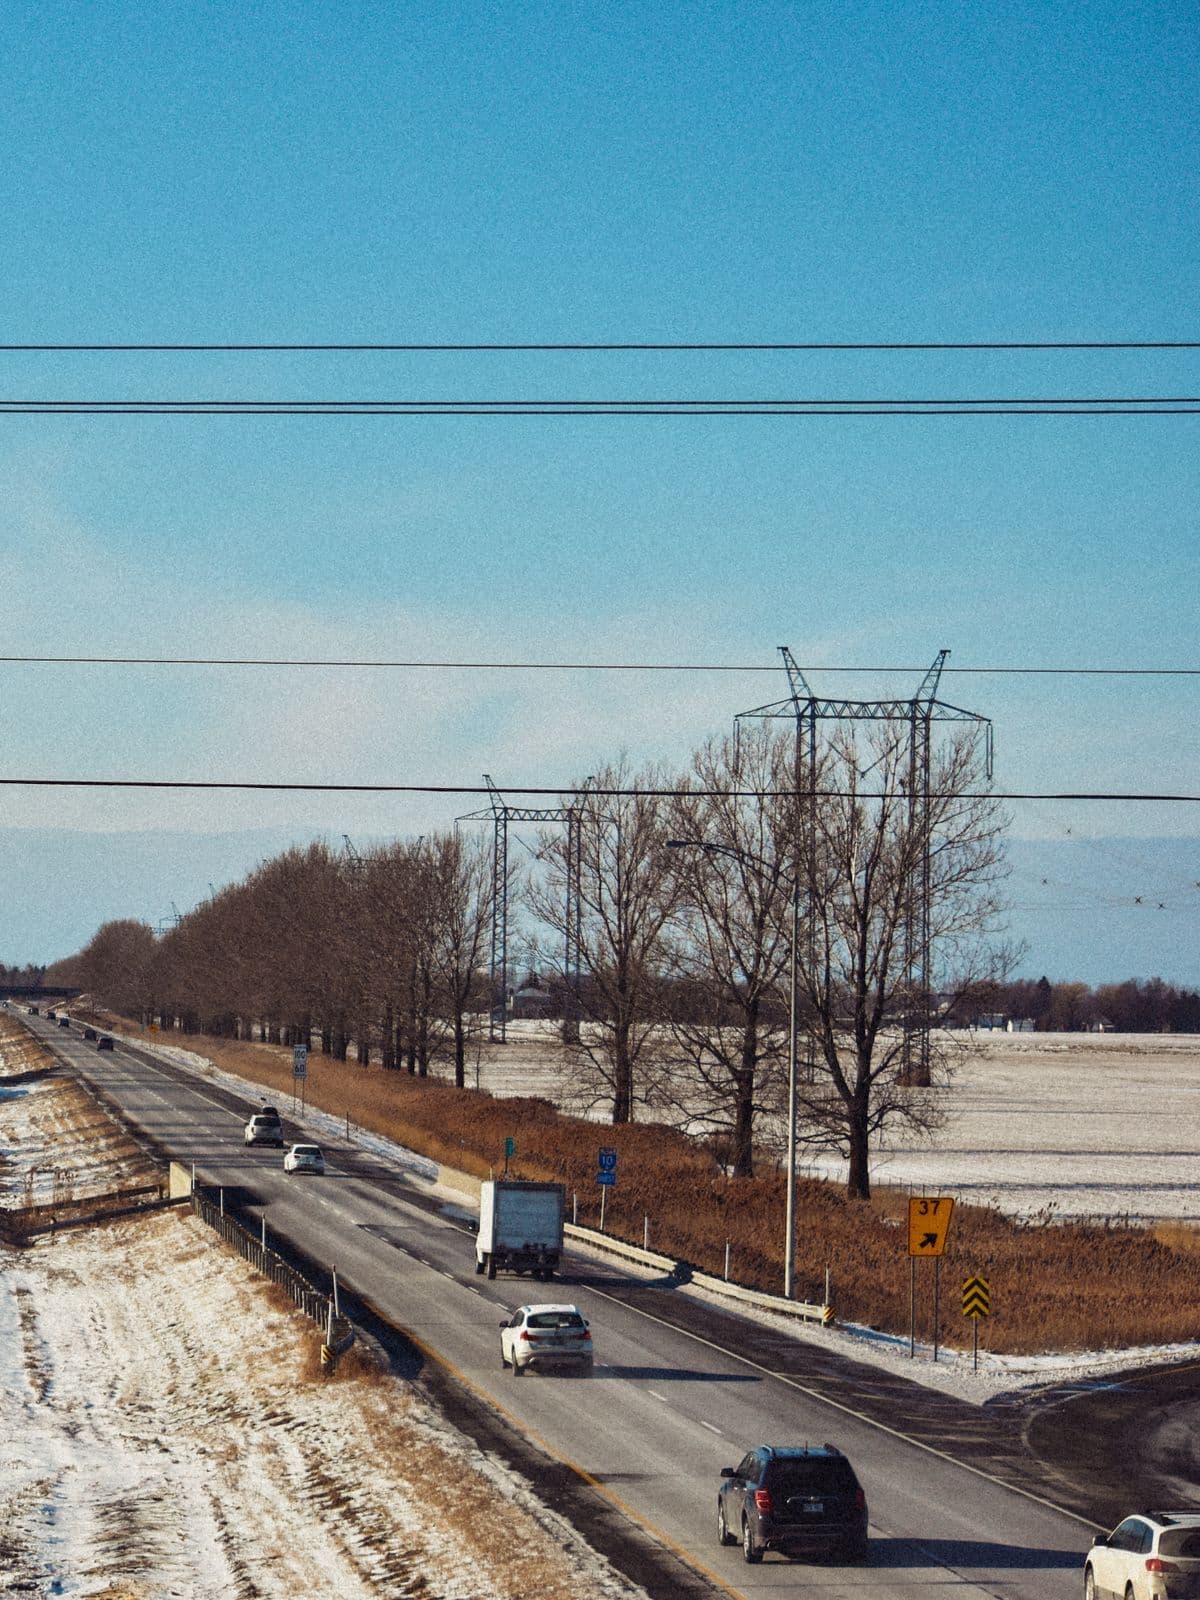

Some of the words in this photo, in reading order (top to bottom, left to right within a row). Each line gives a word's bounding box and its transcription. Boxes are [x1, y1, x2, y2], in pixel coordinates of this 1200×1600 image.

[295, 1050, 305, 1059] 100
[295, 1064, 305, 1073] 60
[602, 1156, 613, 1166] 10
[919, 1200, 940, 1216] 37
